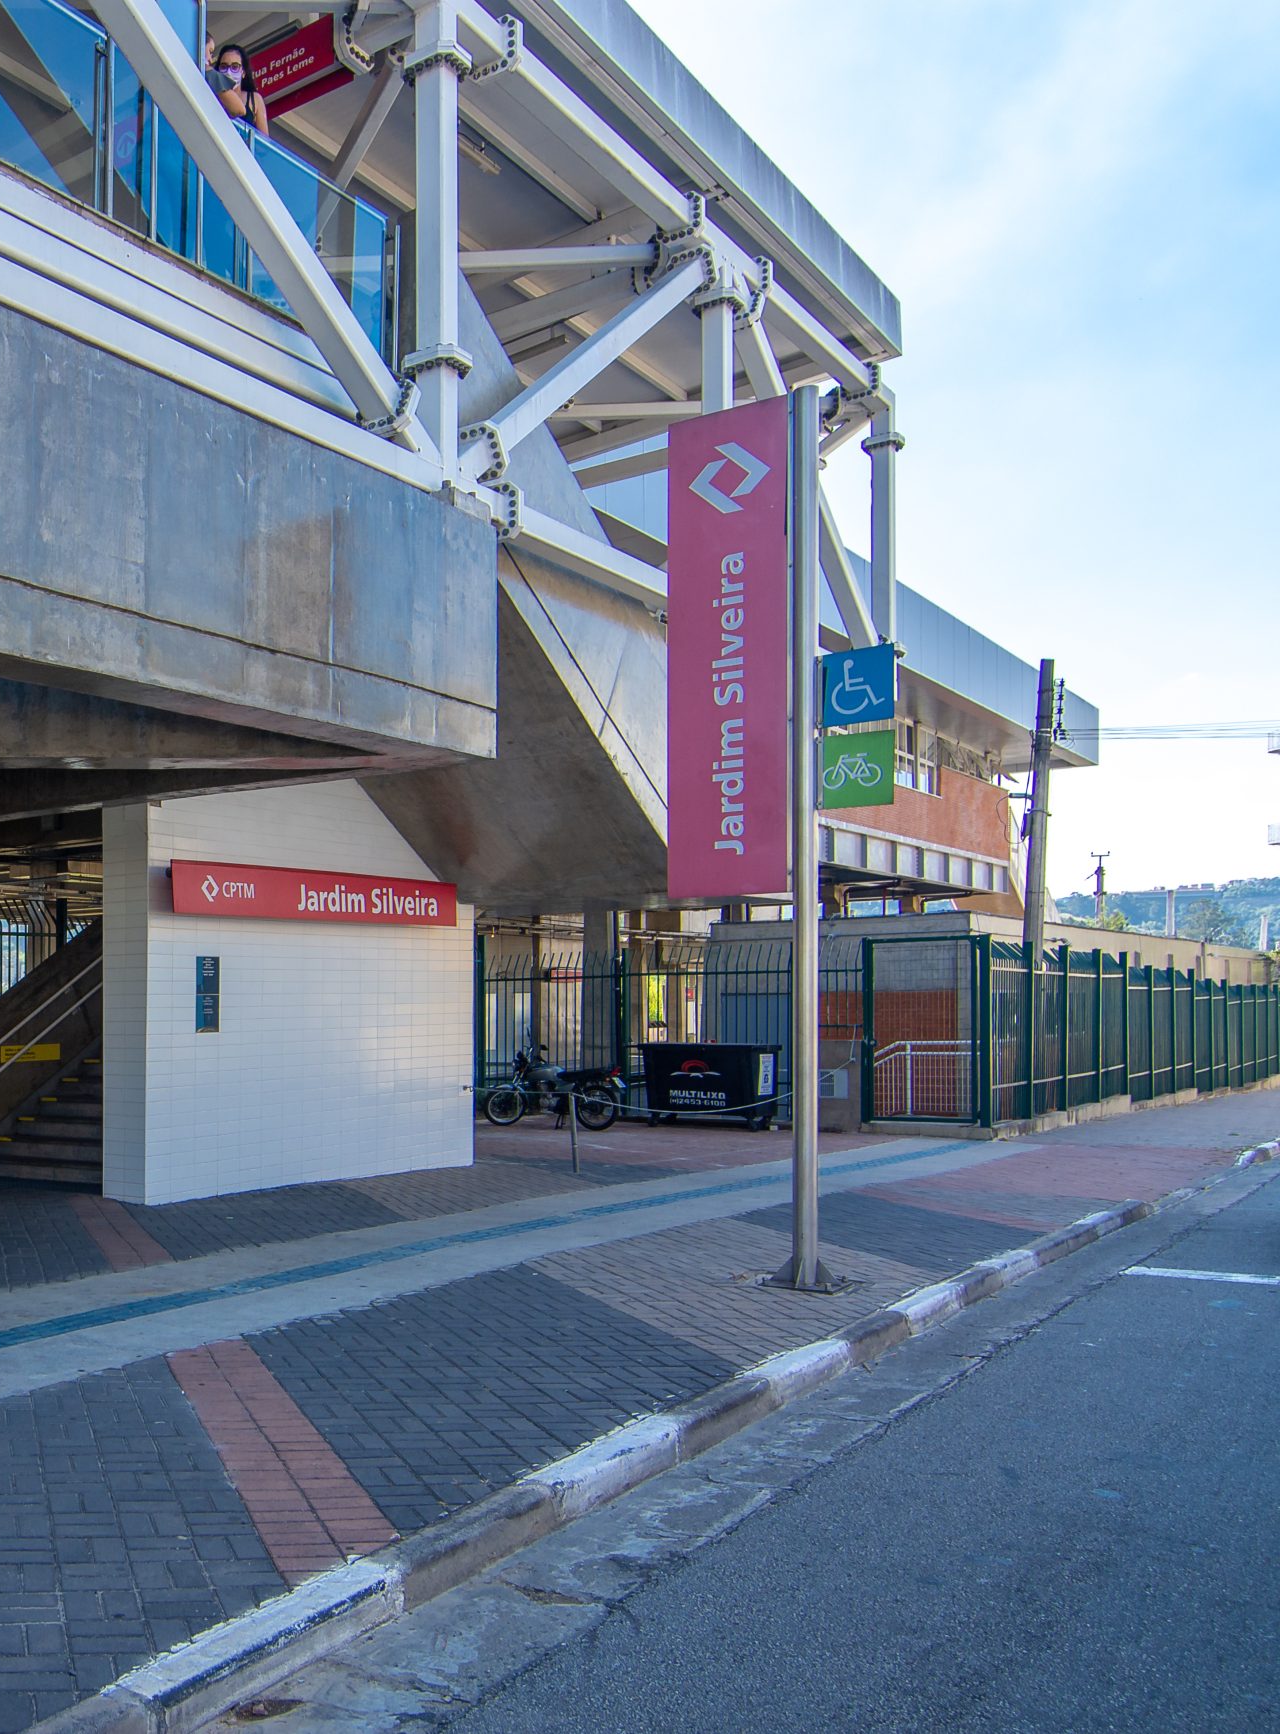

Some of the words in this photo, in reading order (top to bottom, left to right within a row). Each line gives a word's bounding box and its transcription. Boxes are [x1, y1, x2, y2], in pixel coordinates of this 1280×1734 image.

[261, 71, 285, 88] Paes
[286, 55, 315, 75] Leme
[269, 47, 306, 71] Fernão
[711, 551, 745, 706] Silveira
[711, 718, 745, 856] Jardim
[222, 881, 255, 899] CPTM
[297, 883, 366, 914] Jardim
[371, 887, 439, 917] Silveira
[669, 1089, 726, 1100] MULTILIXO
